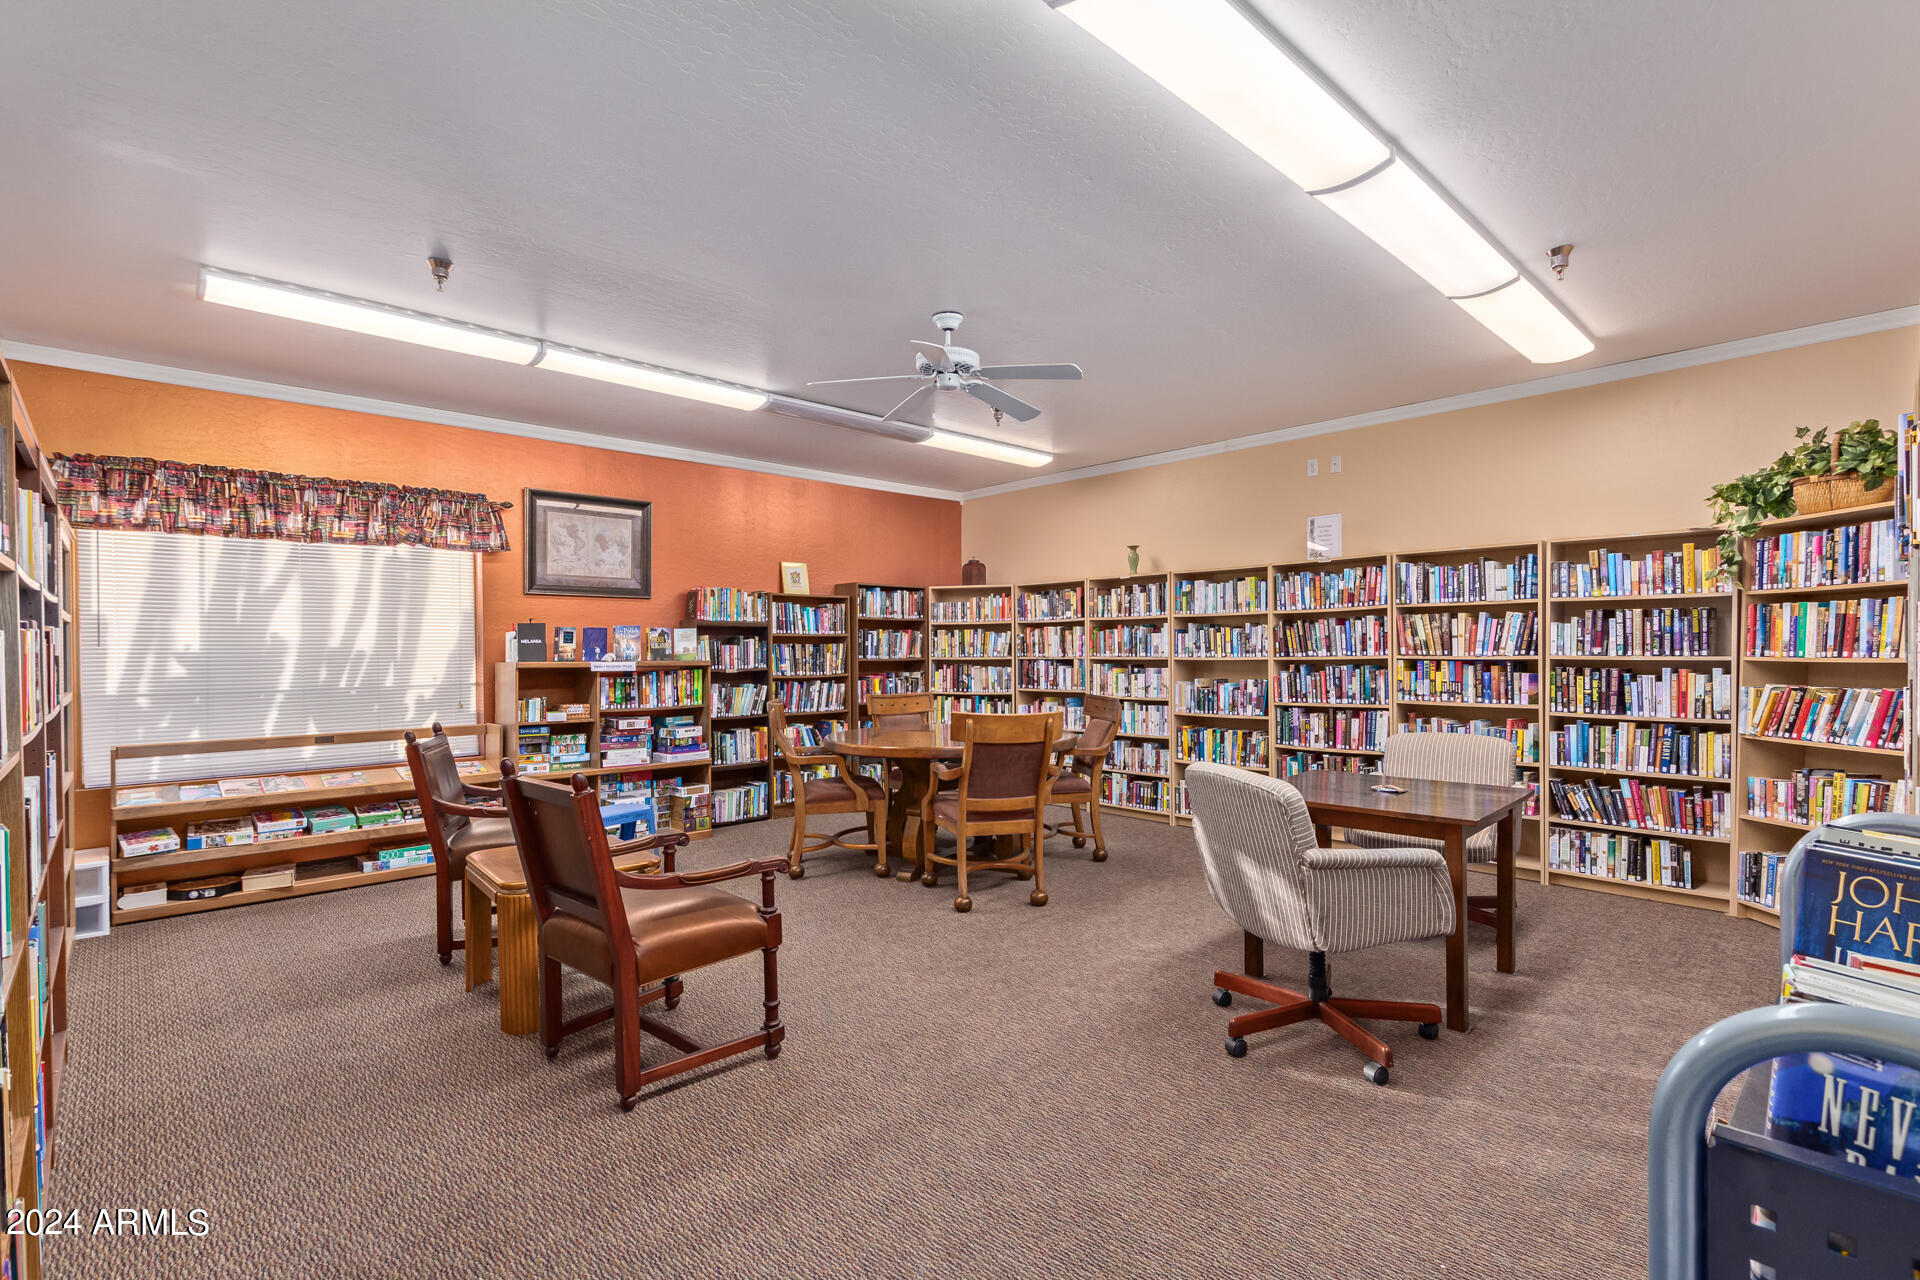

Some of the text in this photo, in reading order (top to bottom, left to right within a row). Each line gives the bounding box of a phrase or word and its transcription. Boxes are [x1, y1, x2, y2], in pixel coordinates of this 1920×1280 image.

[1662, 737, 1671, 760] COLONY
[1851, 864, 1868, 872] TIMES
[1869, 868, 1907, 880] BESTSELLING
